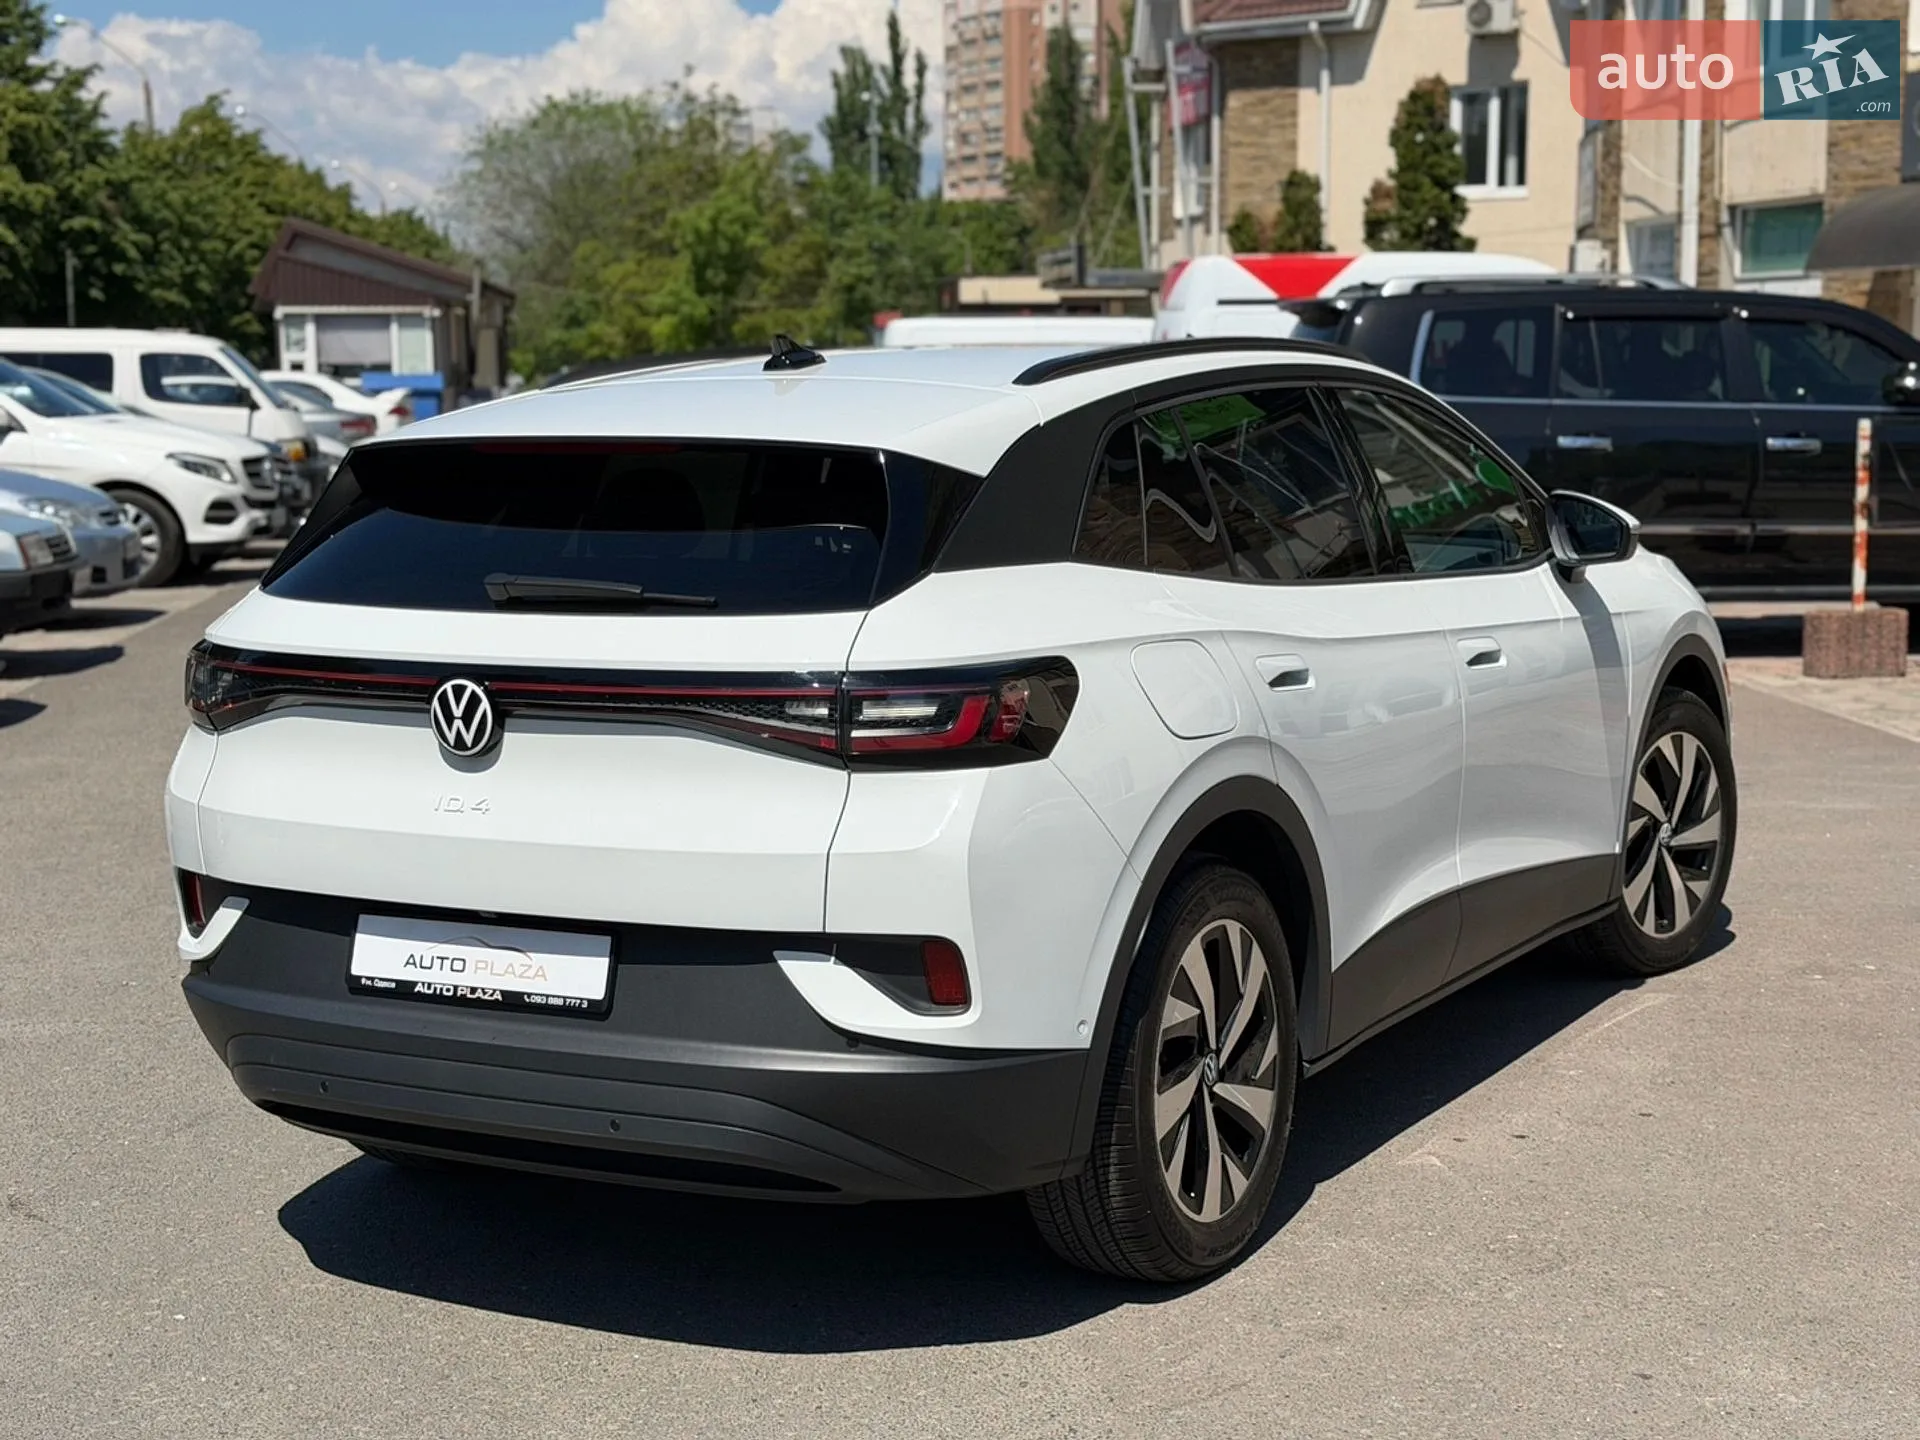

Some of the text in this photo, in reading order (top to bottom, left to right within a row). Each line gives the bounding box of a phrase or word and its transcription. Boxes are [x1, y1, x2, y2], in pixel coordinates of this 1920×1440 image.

[403, 953, 548, 982] AUTO PLAZA
[414, 982, 503, 1001] AUTO PLAZA
